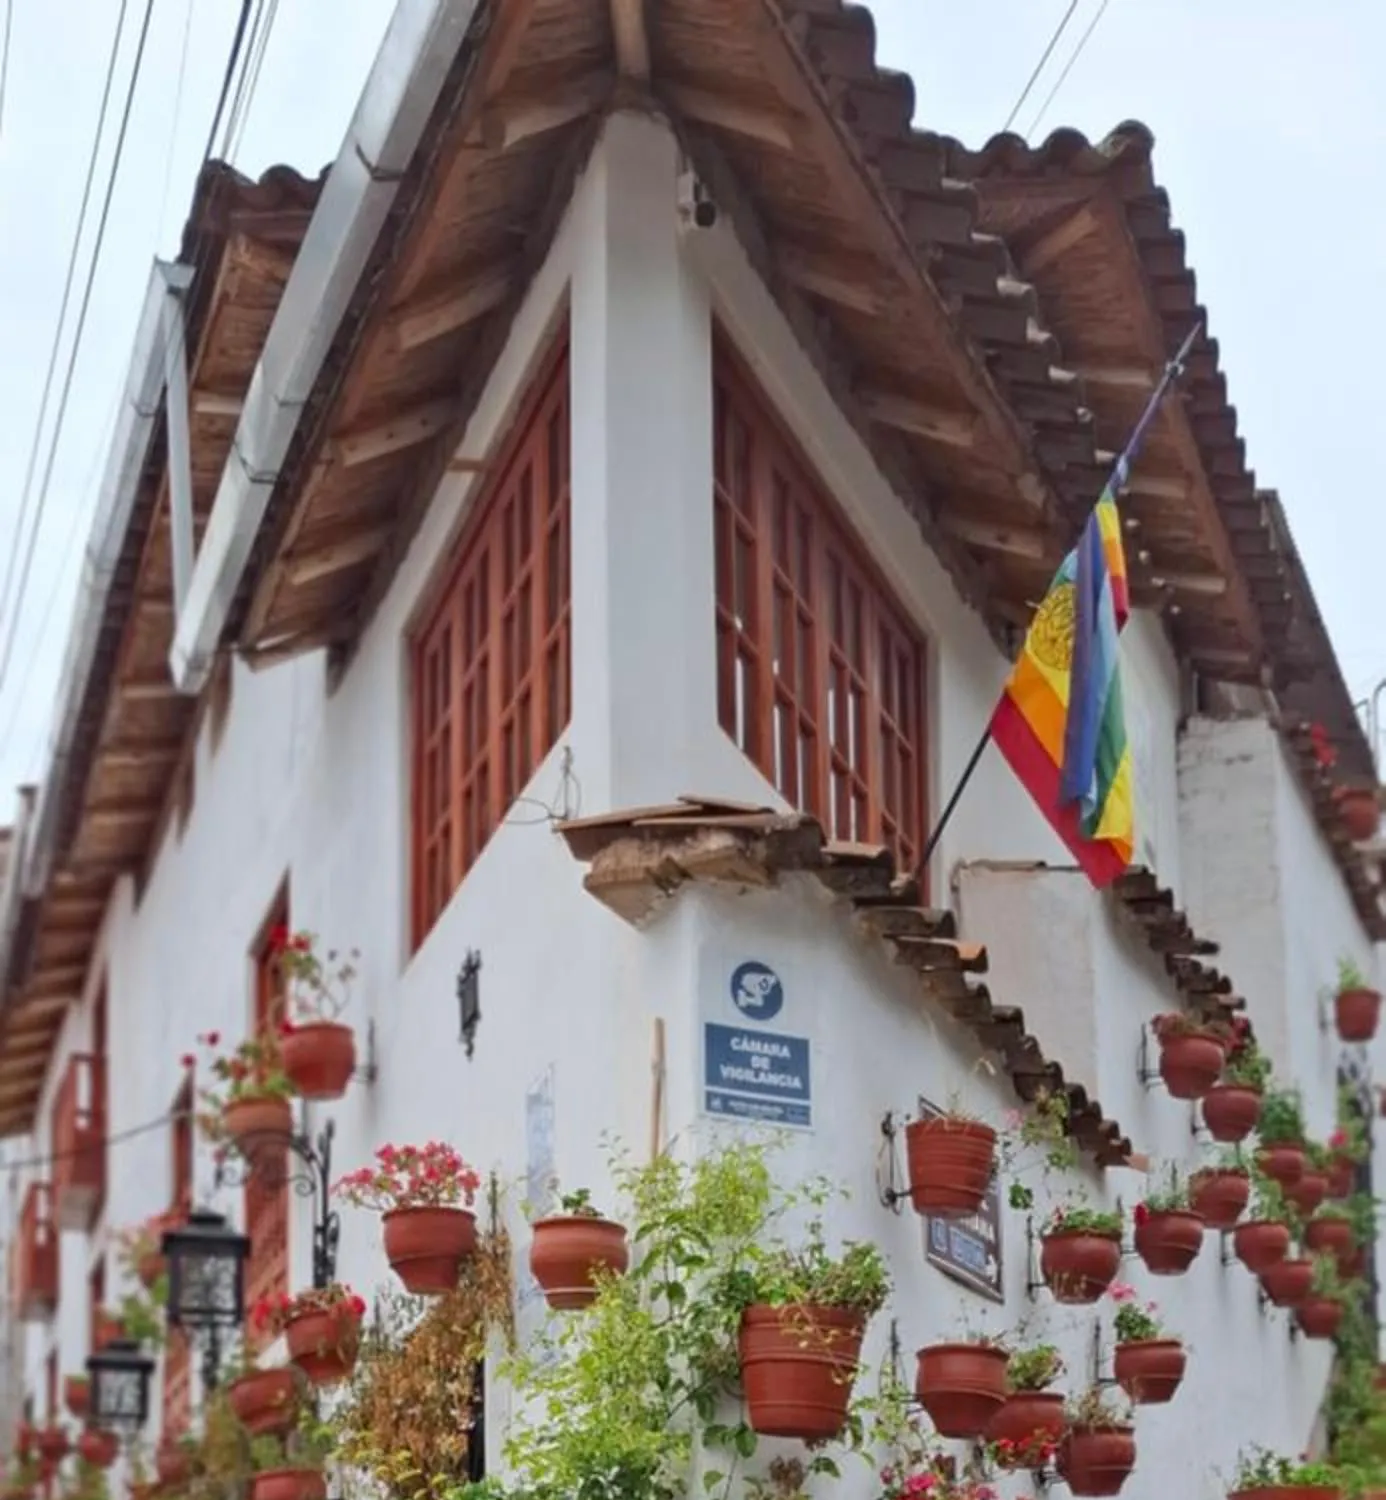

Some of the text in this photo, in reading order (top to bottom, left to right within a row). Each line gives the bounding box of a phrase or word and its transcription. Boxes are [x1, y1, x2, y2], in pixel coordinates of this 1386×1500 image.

[730, 1034, 791, 1058] CÁMARA
[751, 1055, 771, 1070] DE
[720, 1064, 802, 1089] VIGILANCIA
